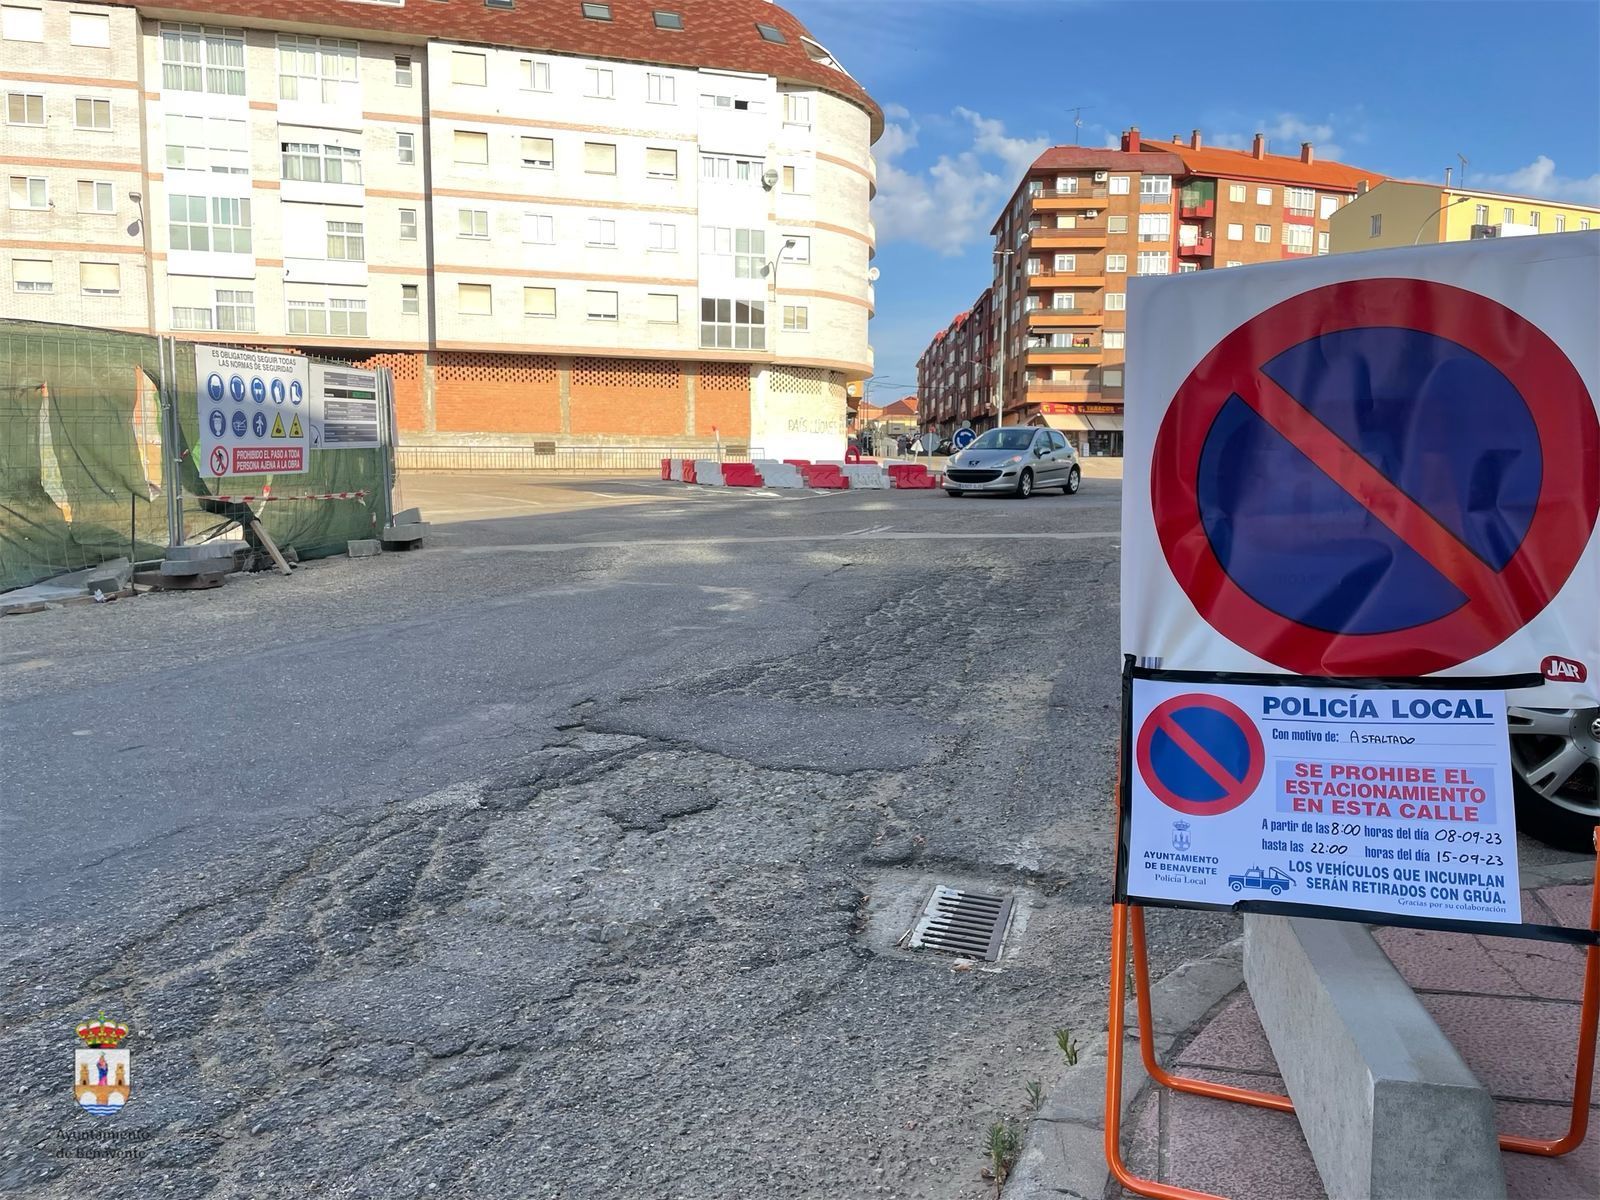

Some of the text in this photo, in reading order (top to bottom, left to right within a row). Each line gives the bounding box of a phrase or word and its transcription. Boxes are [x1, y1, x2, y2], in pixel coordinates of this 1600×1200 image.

[220, 351, 256, 362] OBLIGATORIO
[257, 355, 278, 364] SEGUIR
[279, 357, 296, 365] TODAS
[230, 361, 253, 369] NORMAS
[262, 364, 293, 373] SEGURIDAD
[236, 449, 300, 460] PROHIBIDO EL PASO A TODA
[236, 459, 300, 470] PERSONA AJENA A LA OBRA
[1547, 660, 1580, 679] JAR
[1263, 694, 1493, 718] POLICÍA LOCAL
[1272, 728, 1288, 740] Con
[1291, 729, 1322, 742] motivo
[1325, 731, 1339, 742] de:
[1295, 763, 1474, 784] SE PROHIBE EL
[1286, 780, 1486, 803] ESTACIONAMIENTO
[1293, 798, 1479, 822] EN ESTA CALLE
[1262, 818, 1502, 845] A partir de las 8:00 horas del día 08-09-23
[1144, 851, 1219, 864] AYUNTAMIENTO
[1262, 838, 1503, 866] hasta las 22:00 horas del día 15-09-23
[1160, 863, 1217, 875] BENAVENTE
[1289, 860, 1504, 888] LOS VEHÍCULOS QUE INCUMPLAN
[1155, 874, 1206, 885] Policía Local
[1306, 875, 1506, 904] SERÁN RETIRADOS CON GRÚA.
[1398, 898, 1427, 907] Gracias
[1456, 904, 1506, 913] colaboración
